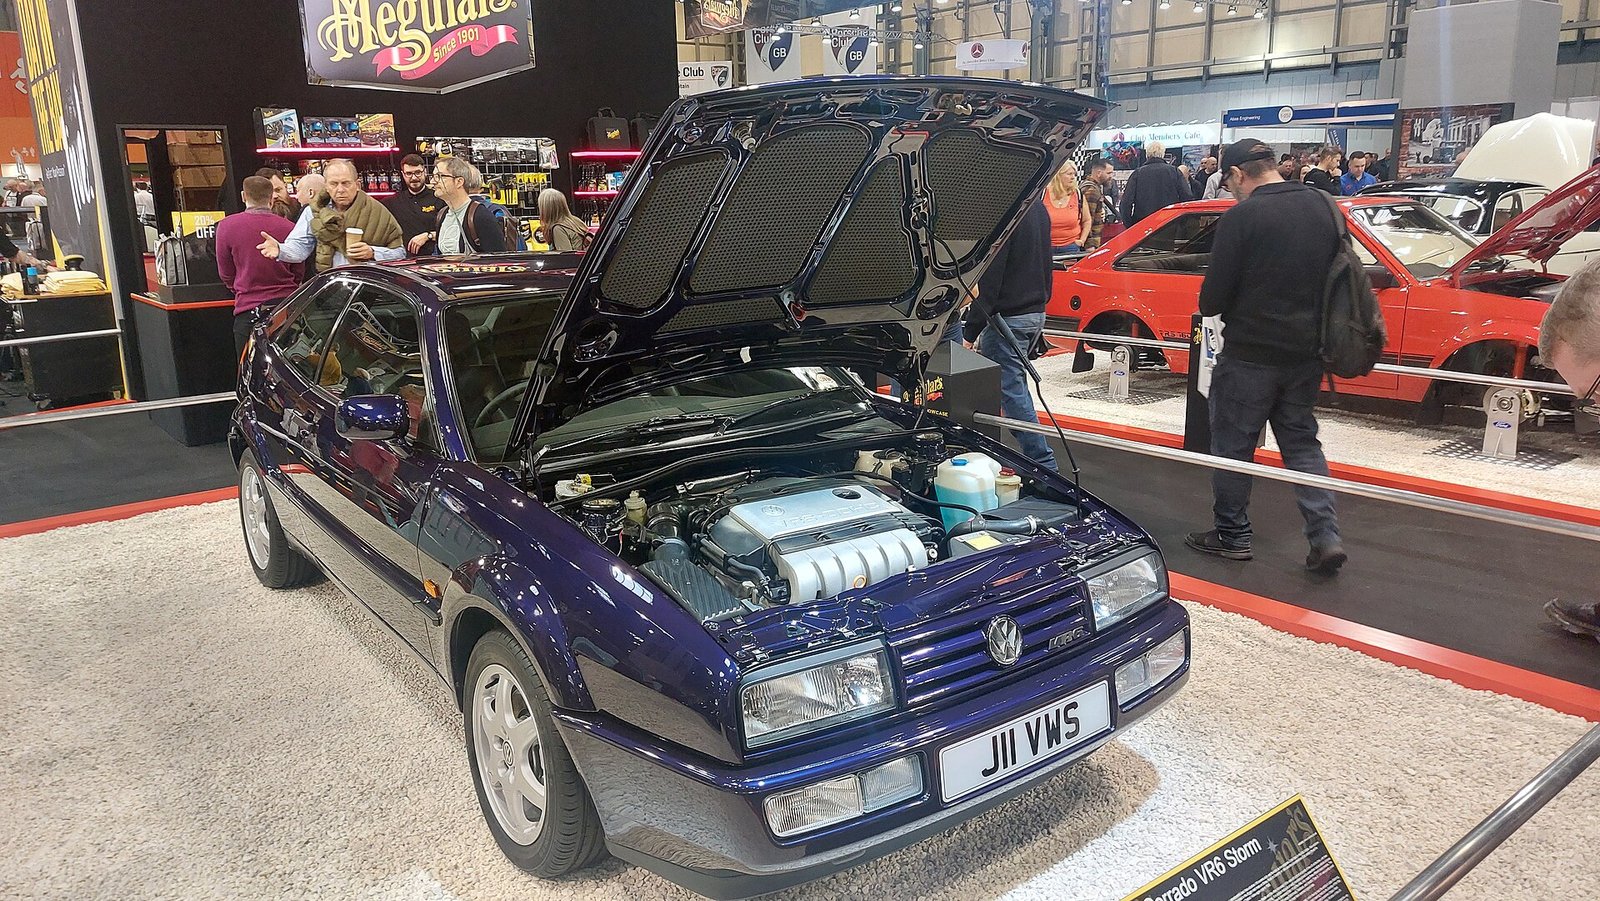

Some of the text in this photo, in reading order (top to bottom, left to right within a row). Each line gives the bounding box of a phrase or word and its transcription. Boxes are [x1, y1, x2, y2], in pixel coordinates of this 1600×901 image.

[433, 28, 479, 62] Since 1901
[773, 48, 787, 58] GB
[849, 50, 863, 61] GB
[683, 66, 704, 77] Club
[194, 215, 215, 226] 20%
[196, 226, 215, 239] OFF
[1025, 701, 1080, 756] VWS
[1193, 856, 1227, 885] VR6
[1223, 838, 1262, 868] Storm
